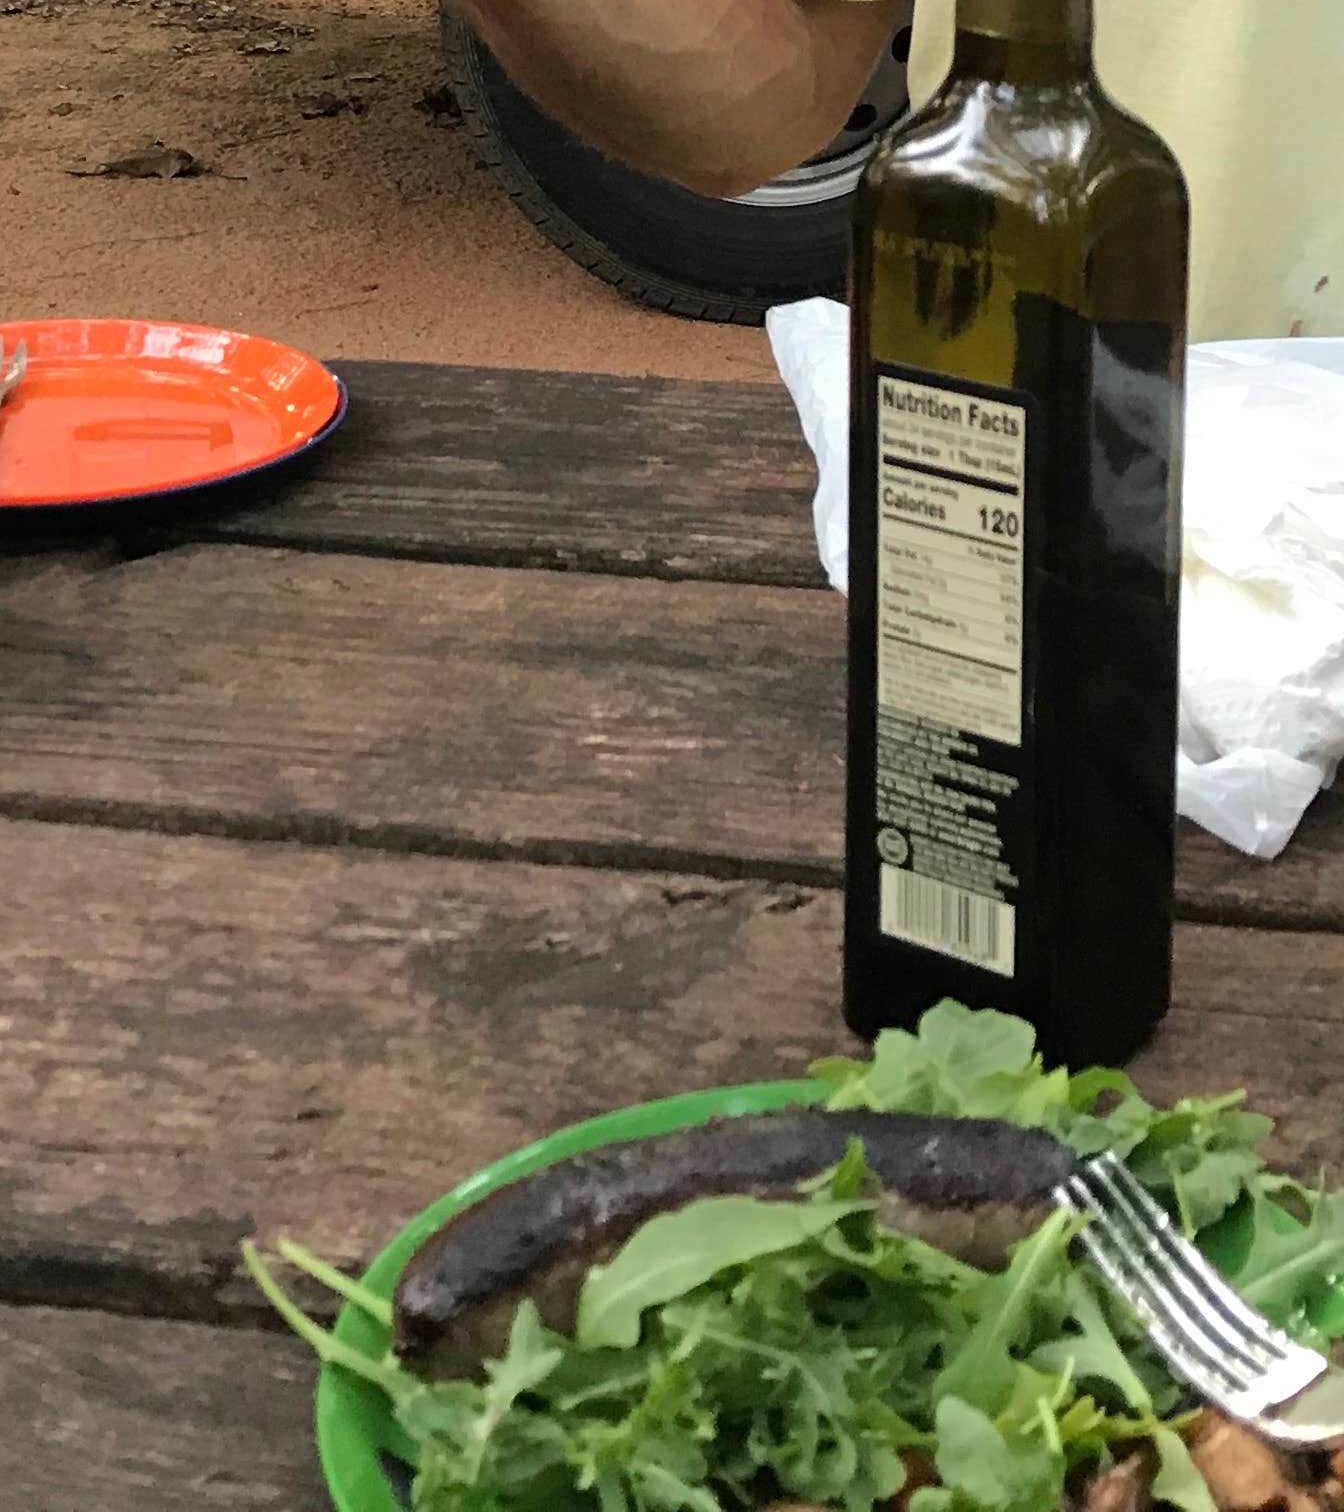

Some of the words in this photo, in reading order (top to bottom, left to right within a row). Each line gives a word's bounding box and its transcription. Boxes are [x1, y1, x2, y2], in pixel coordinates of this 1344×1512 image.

[882, 383, 962, 425] Nutrition
[968, 403, 1020, 437] Facts
[882, 487, 947, 521] Calories
[978, 505, 1020, 538] 120
